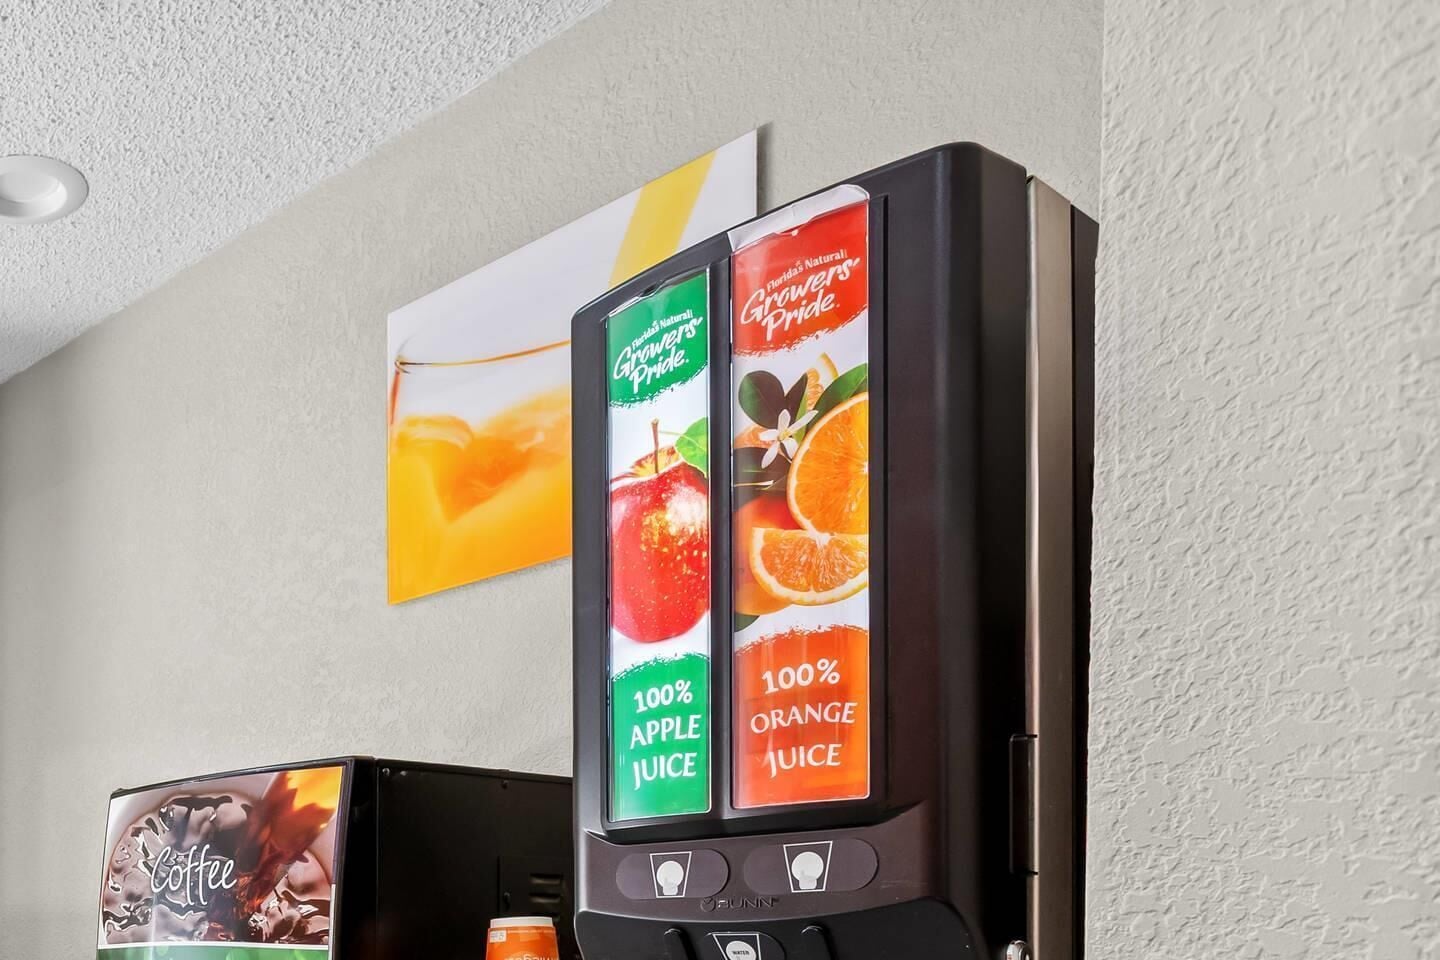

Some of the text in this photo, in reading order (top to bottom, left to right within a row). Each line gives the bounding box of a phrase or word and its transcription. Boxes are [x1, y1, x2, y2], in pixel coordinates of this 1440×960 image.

[761, 658, 841, 695] 100%
[633, 679, 693, 714] 100%
[629, 714, 702, 750] APPLE
[749, 701, 858, 734] ORANGE
[631, 751, 698, 791] JUICE
[768, 743, 843, 778] JUICE
[151, 844, 237, 905] Coffee
[716, 896, 775, 909] BUNN
